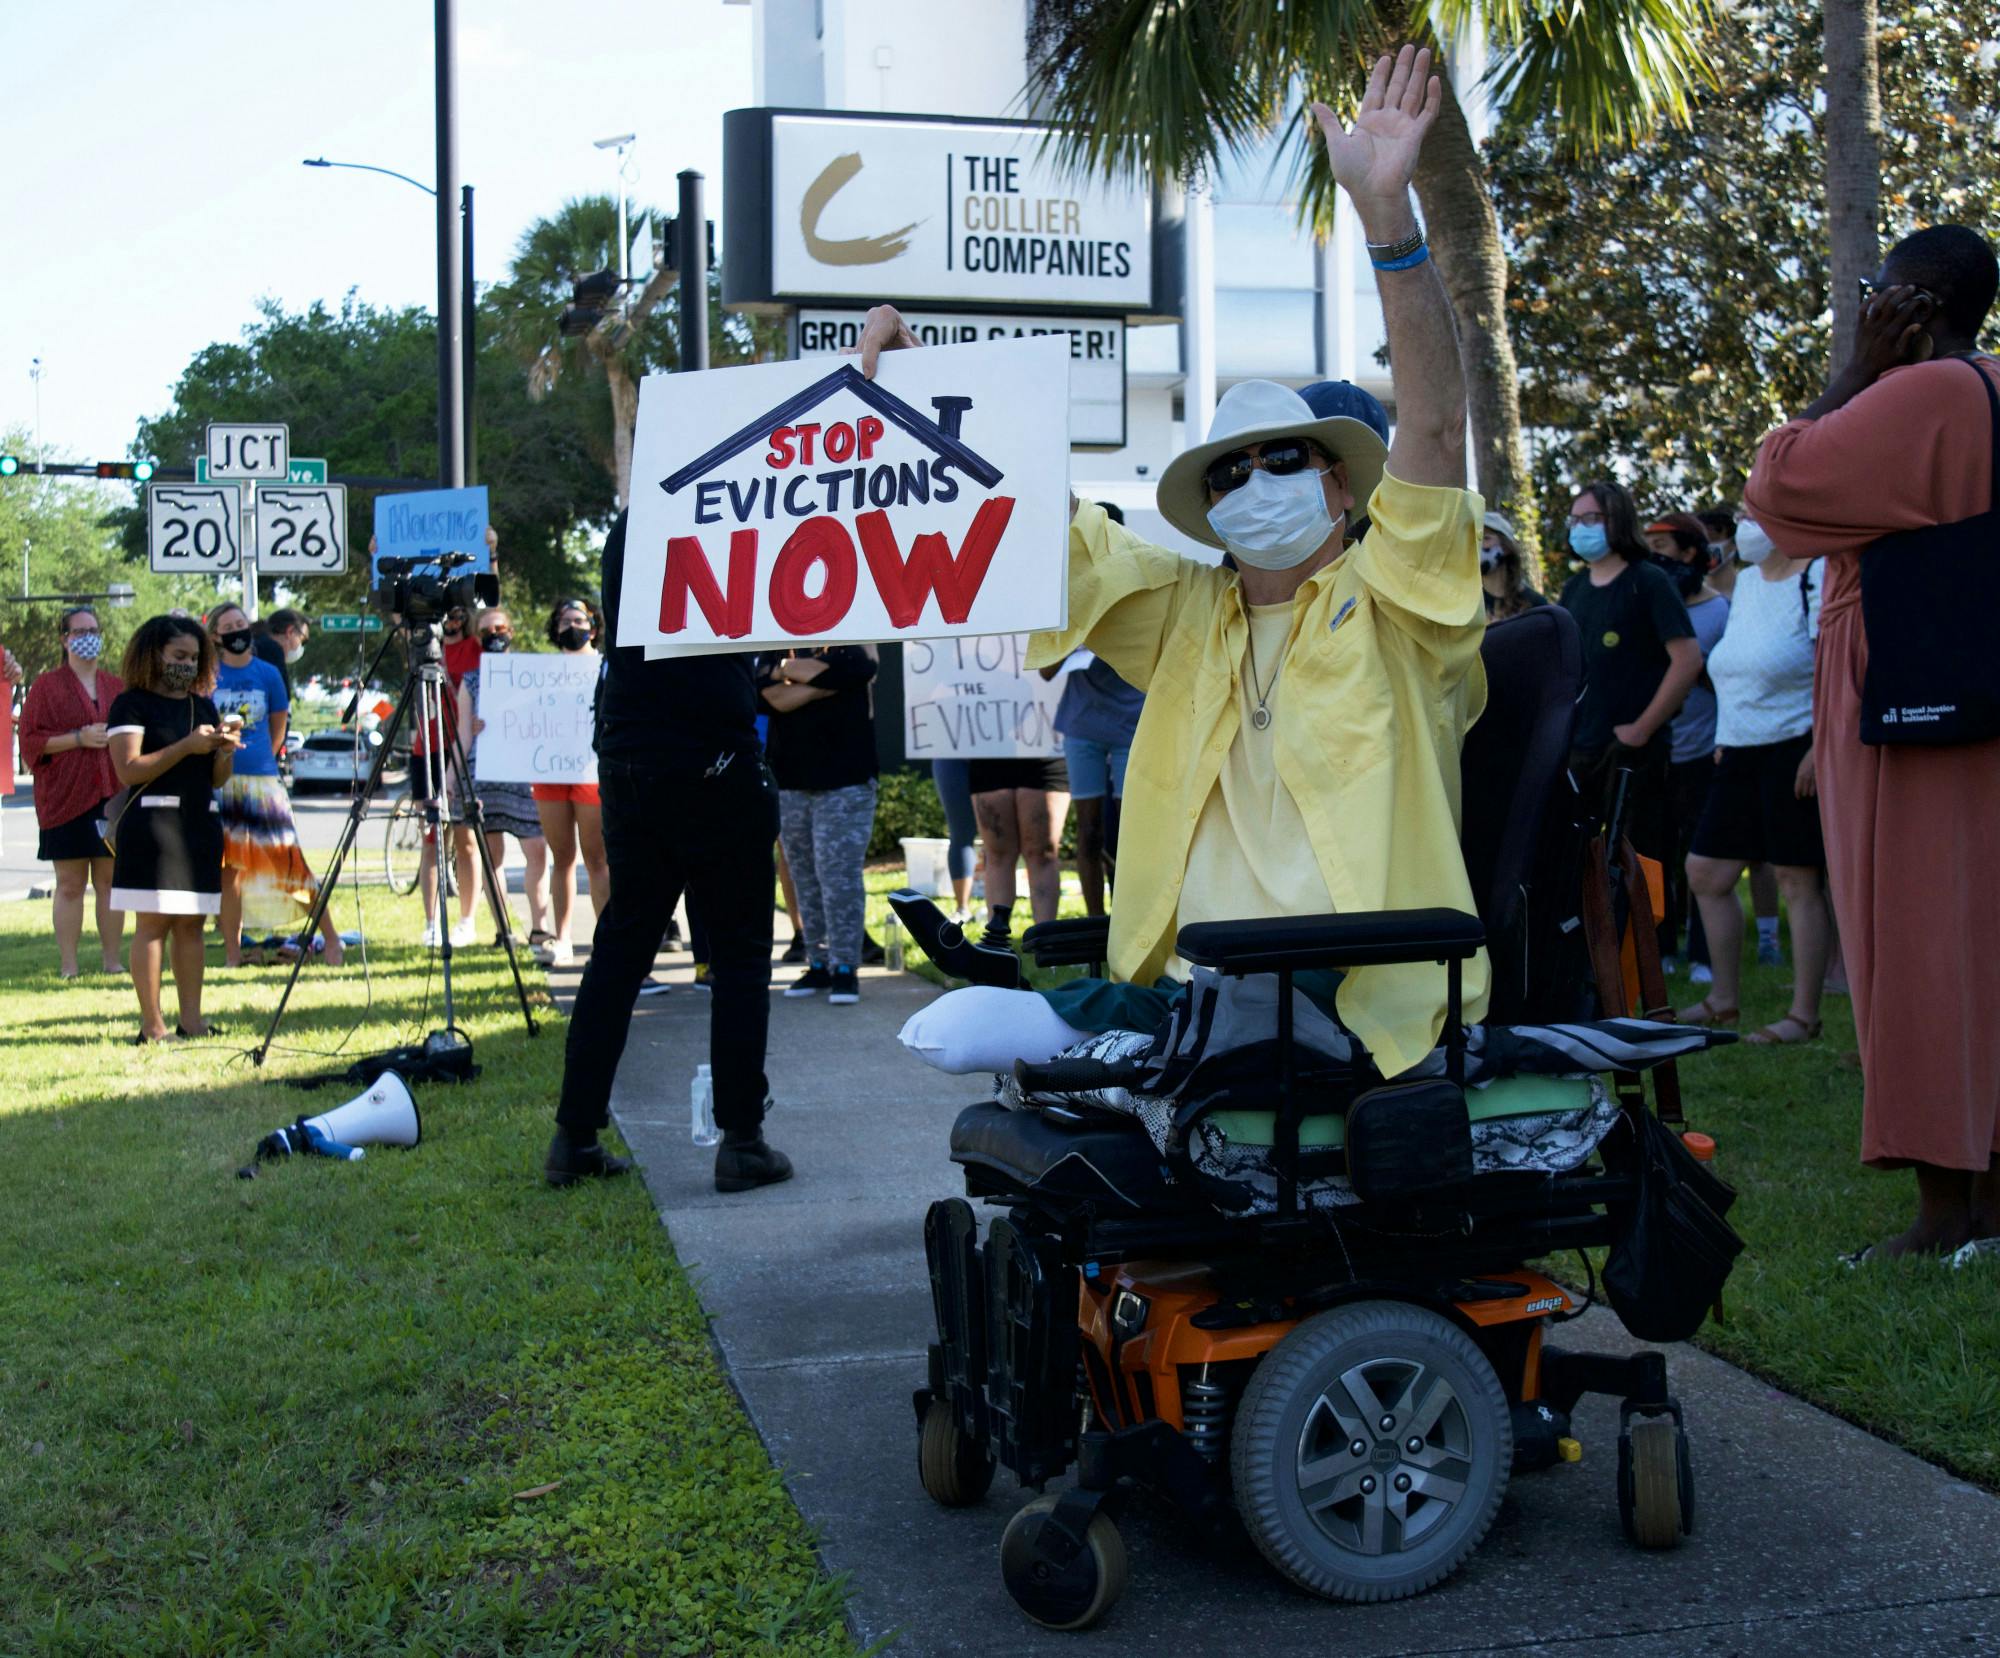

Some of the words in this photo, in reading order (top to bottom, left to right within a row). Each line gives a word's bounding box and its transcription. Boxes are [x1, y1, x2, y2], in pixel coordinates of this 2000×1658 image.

[964, 156, 1019, 193] THE
[965, 195, 1080, 235] COLLIER
[965, 236, 1131, 278] COMPANIES
[801, 321, 864, 351] GRO
[911, 325, 977, 346] OUR
[214, 435, 281, 470] JCT
[766, 415, 884, 469] STOP
[290, 470, 318, 483] ve.
[695, 456, 959, 524] EVICTIONS
[162, 518, 221, 558] 20
[270, 518, 327, 557] 26
[658, 496, 1016, 639] NOW
[538, 692, 556, 706] is
[577, 694, 585, 705] a
[951, 682, 987, 695] THE
[504, 709, 564, 740] Public
